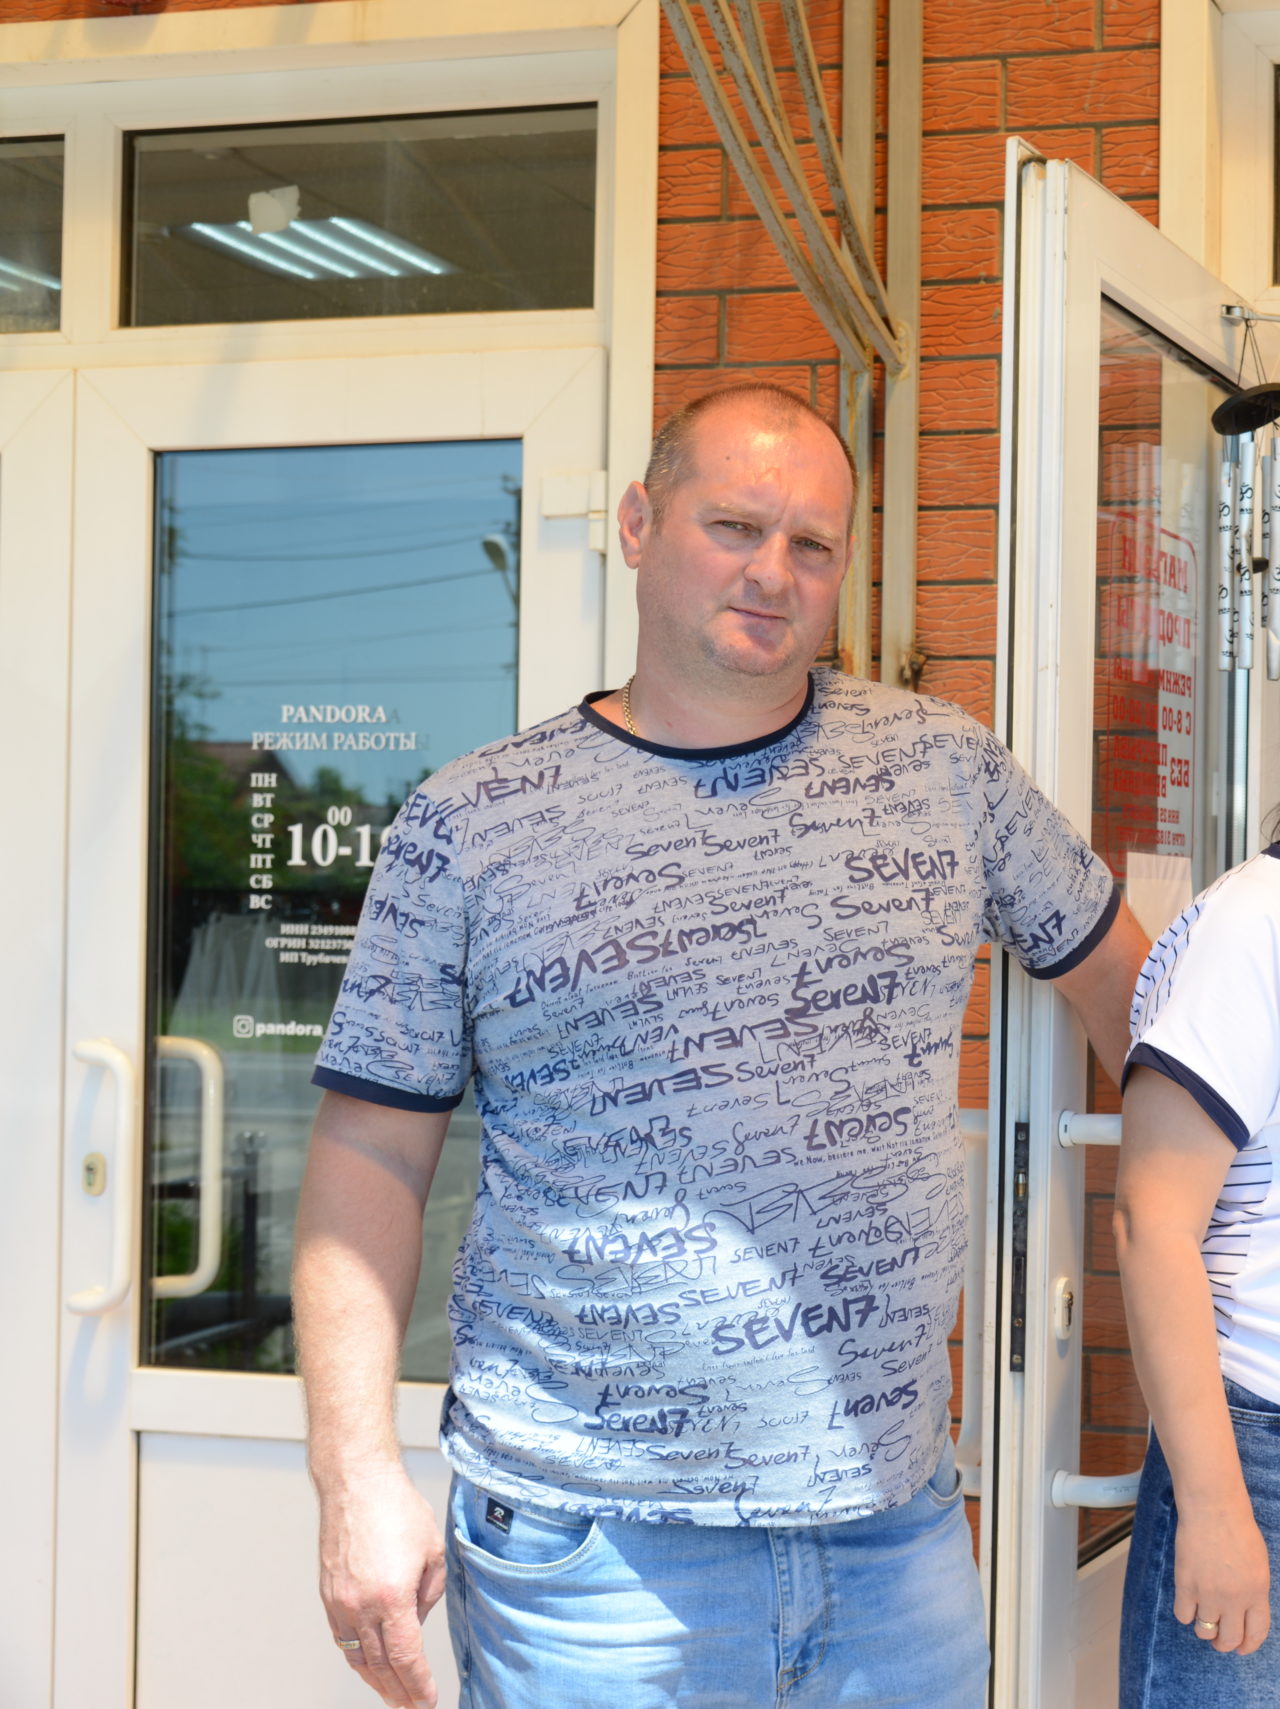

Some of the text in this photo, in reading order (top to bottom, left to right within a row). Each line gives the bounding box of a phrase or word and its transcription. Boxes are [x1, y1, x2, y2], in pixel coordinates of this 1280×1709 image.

[281, 705, 387, 723] PANDORA
[252, 732, 417, 751] РЕЖИМ РАБОТЫ
[250, 772, 277, 788] ПН
[637, 775, 688, 796] SEVEN7
[804, 774, 896, 799] SEVEN7
[252, 793, 274, 808] ВТ
[251, 813, 274, 829] СР
[251, 833, 274, 849] ЧТ
[286, 823, 391, 867] 10-1
[703, 829, 782, 857] Seven7
[250, 854, 272, 870] ПТ
[844, 847, 960, 884] SEVEN7
[250, 874, 273, 890] СБ
[249, 894, 272, 910] ВС
[708, 889, 787, 916] Seven7
[829, 887, 936, 920] Seven7
[822, 920, 889, 943] SEVEN7
[731, 937, 799, 959] SEVEN7
[504, 930, 660, 1009] SEVEN7
[557, 993, 665, 1040] SEVEN7
[879, 1027, 933, 1052] SEVEN7
[735, 1054, 817, 1080] Seven7
[589, 1062, 734, 1117] SEVEN7
[562, 1221, 719, 1266] SEVEN7
[731, 1237, 801, 1263] SEVEN7
[819, 1247, 921, 1281] SEVEN7
[679, 1262, 804, 1307] SEVEN7
[574, 1301, 682, 1327] SEVEN7
[711, 1294, 881, 1358] SEVEN7
[827, 1379, 919, 1431] Seven7
[724, 1445, 811, 1470] Seven7
